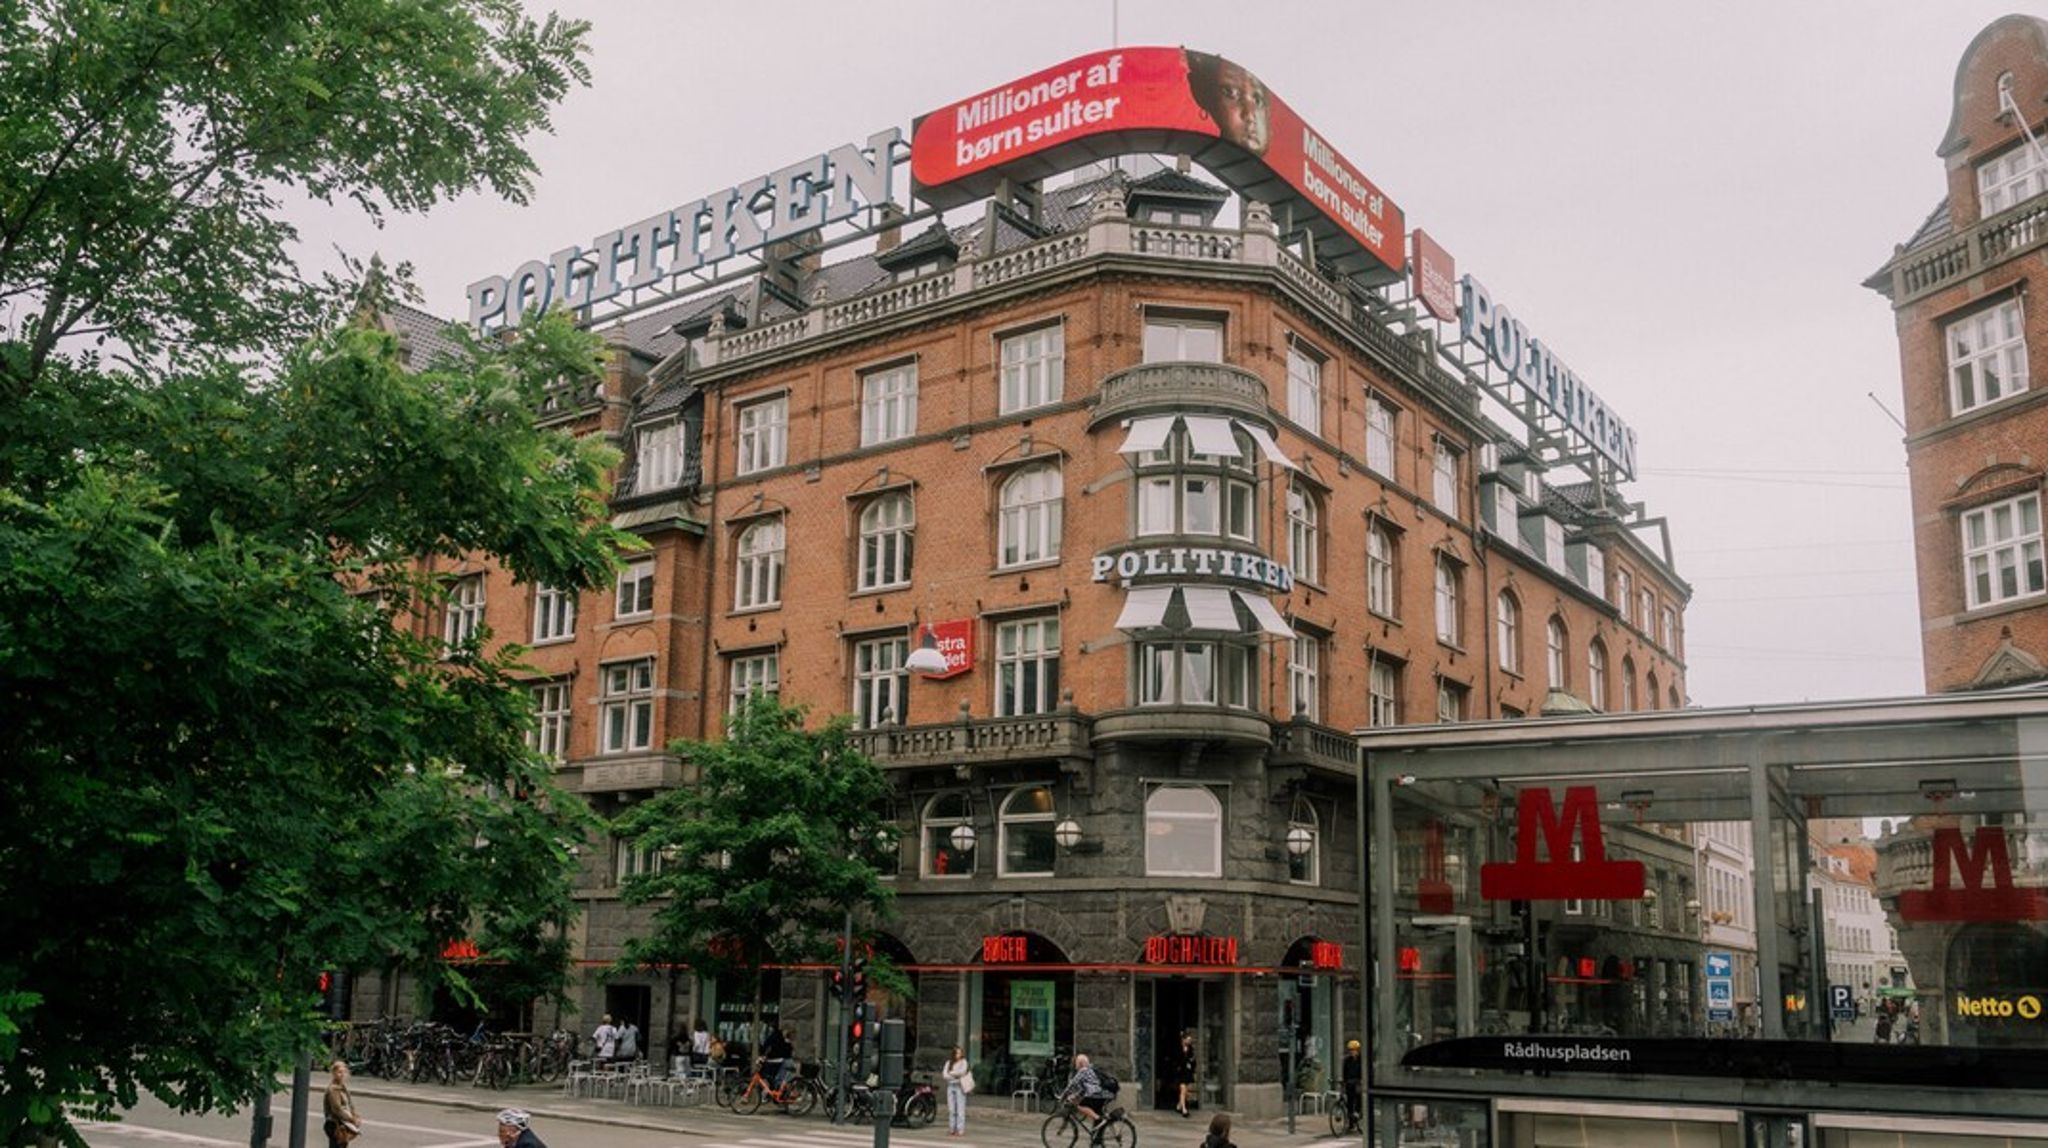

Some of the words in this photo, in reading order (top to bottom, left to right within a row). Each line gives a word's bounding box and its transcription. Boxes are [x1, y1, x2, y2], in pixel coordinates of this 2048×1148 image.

[956, 70, 1083, 134] Millioner
[1086, 54, 1123, 89] af
[956, 126, 1024, 167] børn
[1026, 96, 1121, 142] sulter
[1303, 126, 1368, 205] Millioner
[1369, 193, 1384, 221] af
[1303, 158, 1342, 213] børn
[1341, 200, 1385, 249] sulter
[467, 126, 902, 336] POLITIKEN
[1461, 273, 1638, 482] POLITIKEN
[1091, 548, 1296, 593] POLITIKEN
[937, 636, 966, 652] stra
[1834, 987, 1848, 1006] P
[1957, 996, 2014, 1017] Netto
[1504, 1041, 1632, 1063] Rådhuspladsen
